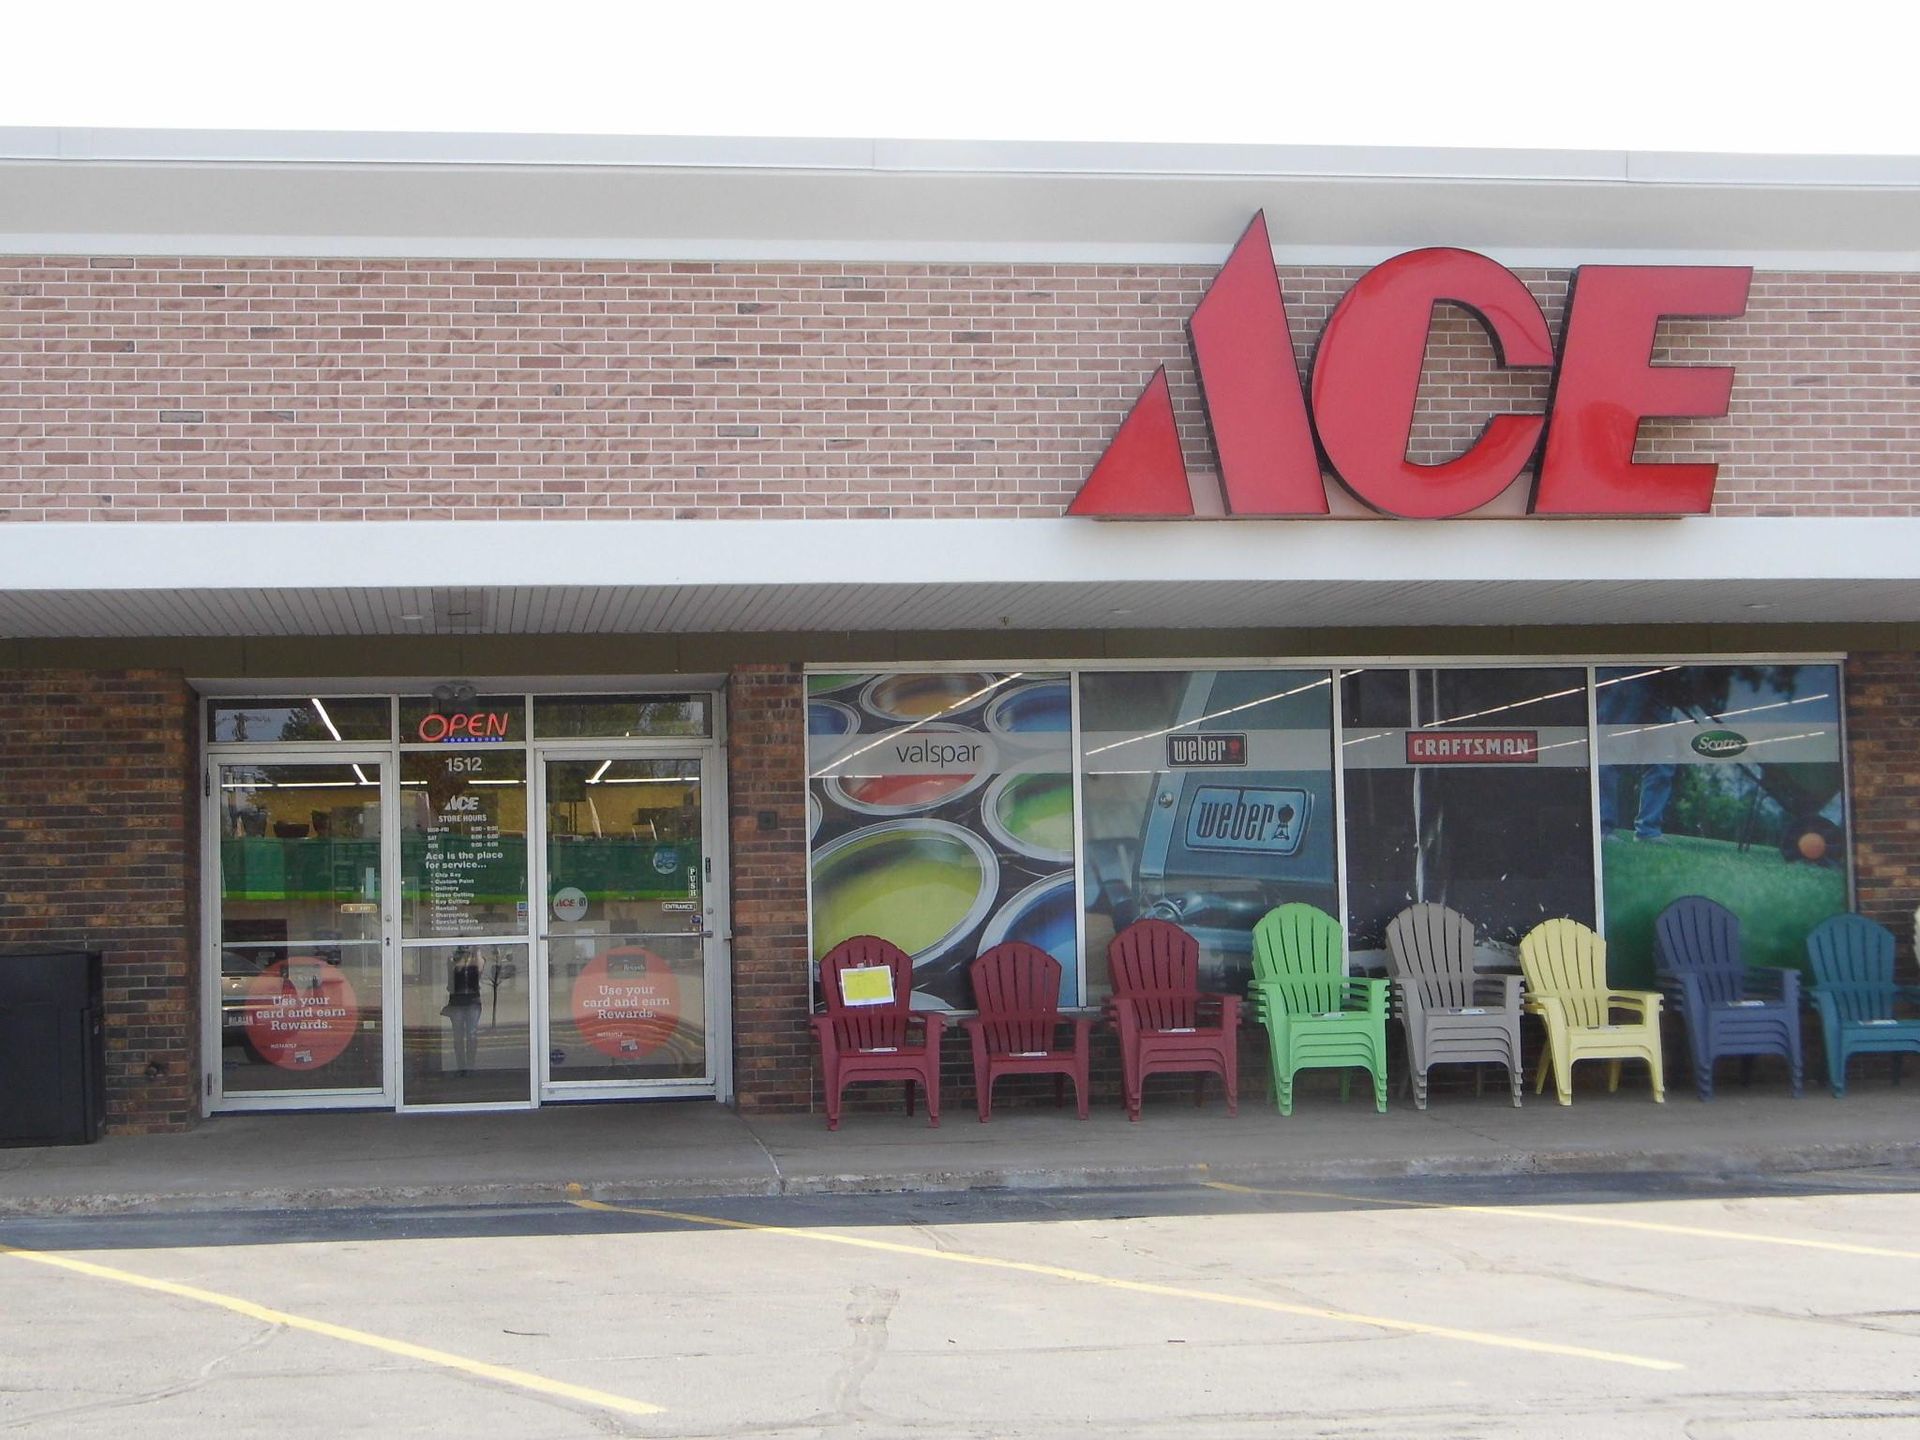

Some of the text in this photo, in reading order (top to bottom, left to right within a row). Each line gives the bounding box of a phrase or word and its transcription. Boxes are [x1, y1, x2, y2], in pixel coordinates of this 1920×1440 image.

[1066, 207, 1753, 520] ACE
[419, 712, 508, 742] OPEN
[896, 738, 983, 768] valspar
[1173, 735, 1226, 762] weber
[1414, 739, 1529, 755] CRAFTSMAN
[445, 757, 482, 772] 1512
[444, 795, 479, 810] ACE
[439, 814, 487, 823] STORE HOURS
[1196, 791, 1275, 841] weber
[426, 851, 503, 860] Ace is the place
[426, 861, 440, 869] for
[599, 985, 656, 996] Use your
[272, 995, 330, 1008] Use your
[583, 996, 670, 1008] card and earn
[256, 1007, 346, 1019] card and earn
[598, 1007, 657, 1020] Rewards.
[271, 1018, 333, 1031] Rewards.
